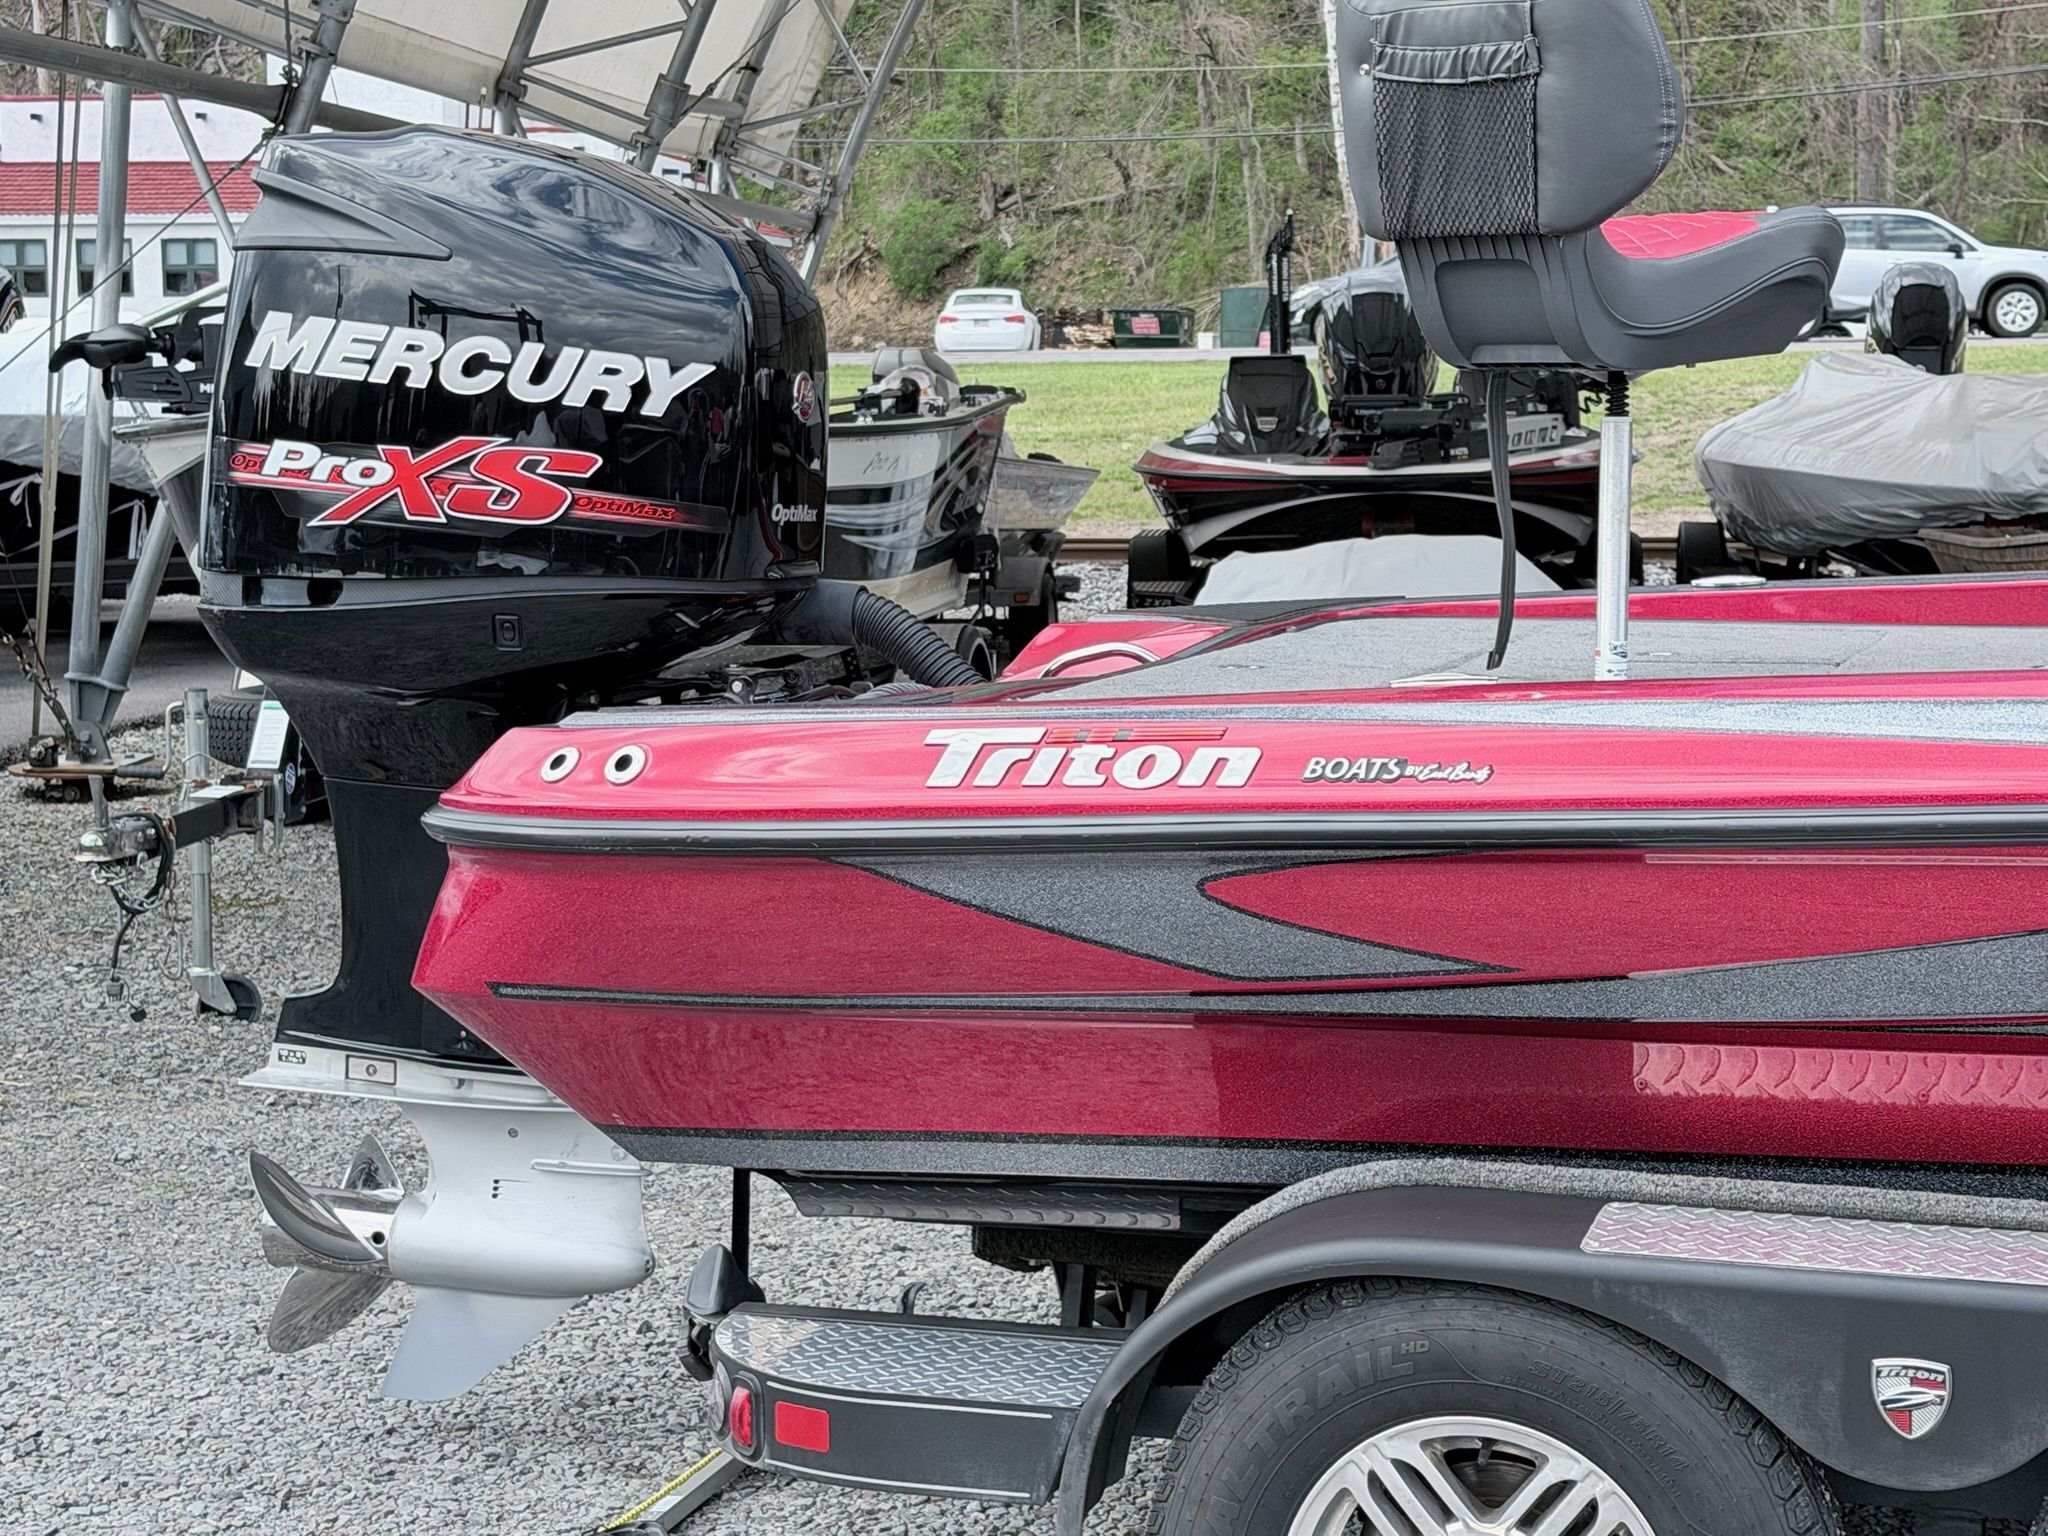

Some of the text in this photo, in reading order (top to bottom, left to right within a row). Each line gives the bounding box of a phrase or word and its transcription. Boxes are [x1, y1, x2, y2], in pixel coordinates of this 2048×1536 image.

[245, 310, 716, 417] MERCURY
[575, 496, 677, 519] OptiMax
[771, 503, 818, 526] OptiMax
[923, 727, 1262, 790] Triton
[1302, 756, 1401, 781] BOATS
[1404, 765, 1424, 777] BY
[1400, 1340, 1430, 1355] HD
[1878, 1366, 1945, 1382] Triton
[1243, 1345, 1414, 1459] TRAIL
